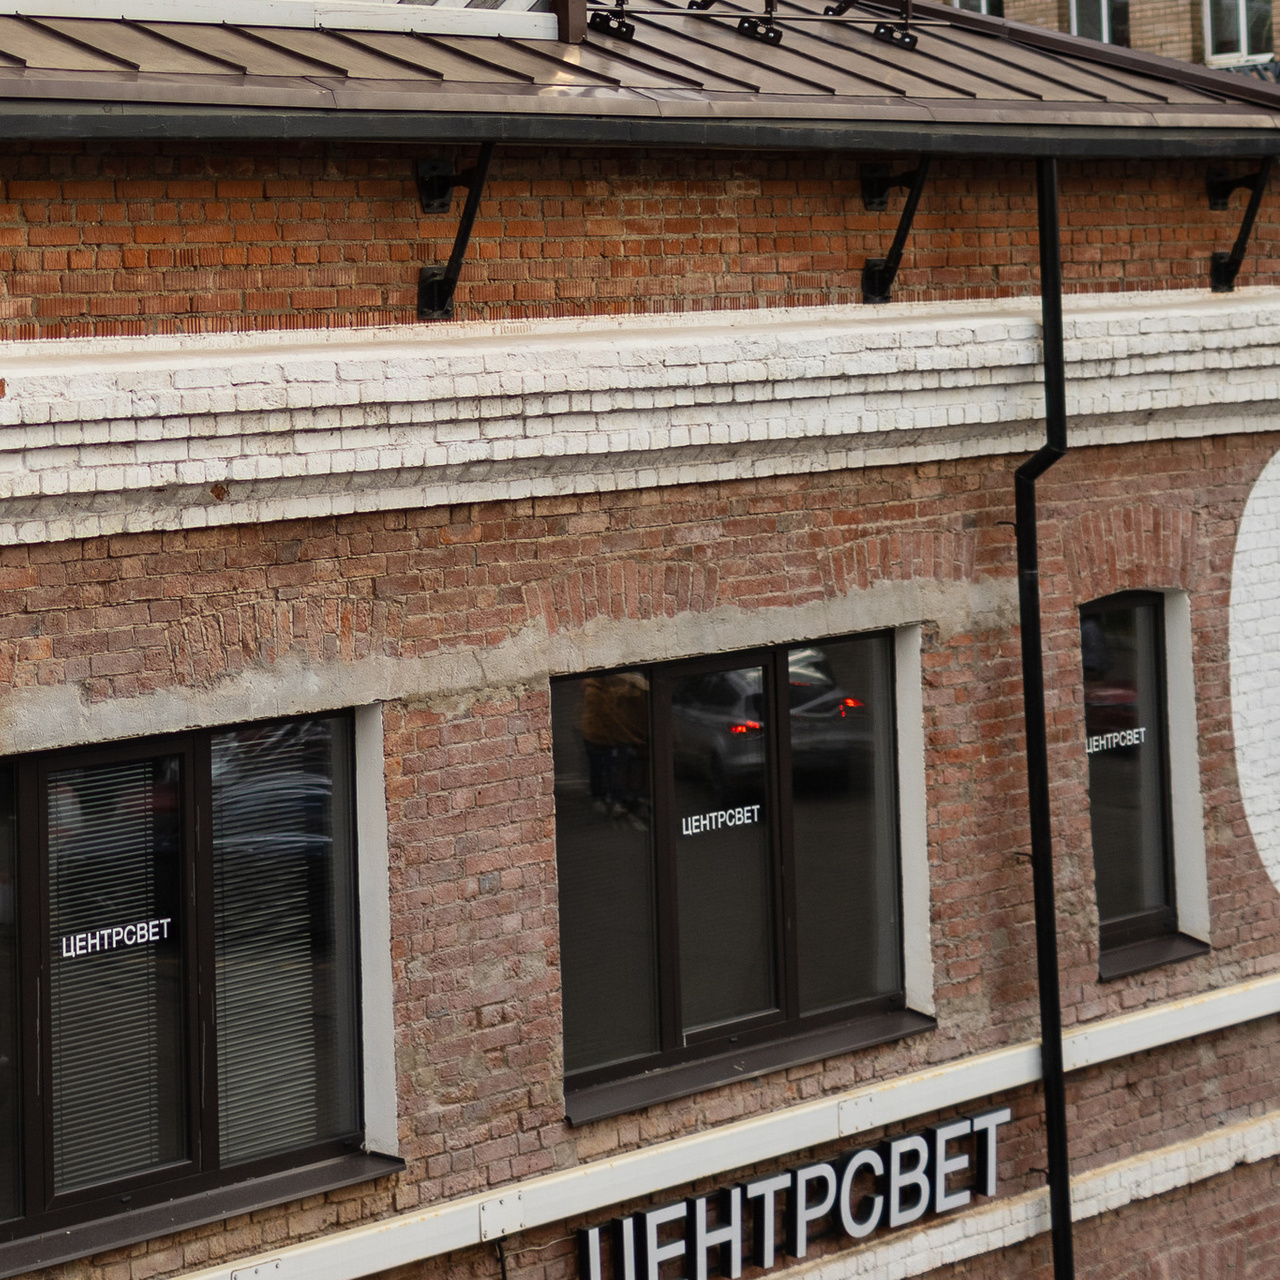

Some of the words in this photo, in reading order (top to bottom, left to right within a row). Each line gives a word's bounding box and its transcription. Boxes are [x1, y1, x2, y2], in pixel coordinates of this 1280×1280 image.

[1085, 727, 1146, 754] ЦЕНТРСВЕТ
[682, 804, 761, 836] ЦЕНТРСВЕТ
[62, 918, 171, 958] ЦЕНТРСВЕТ
